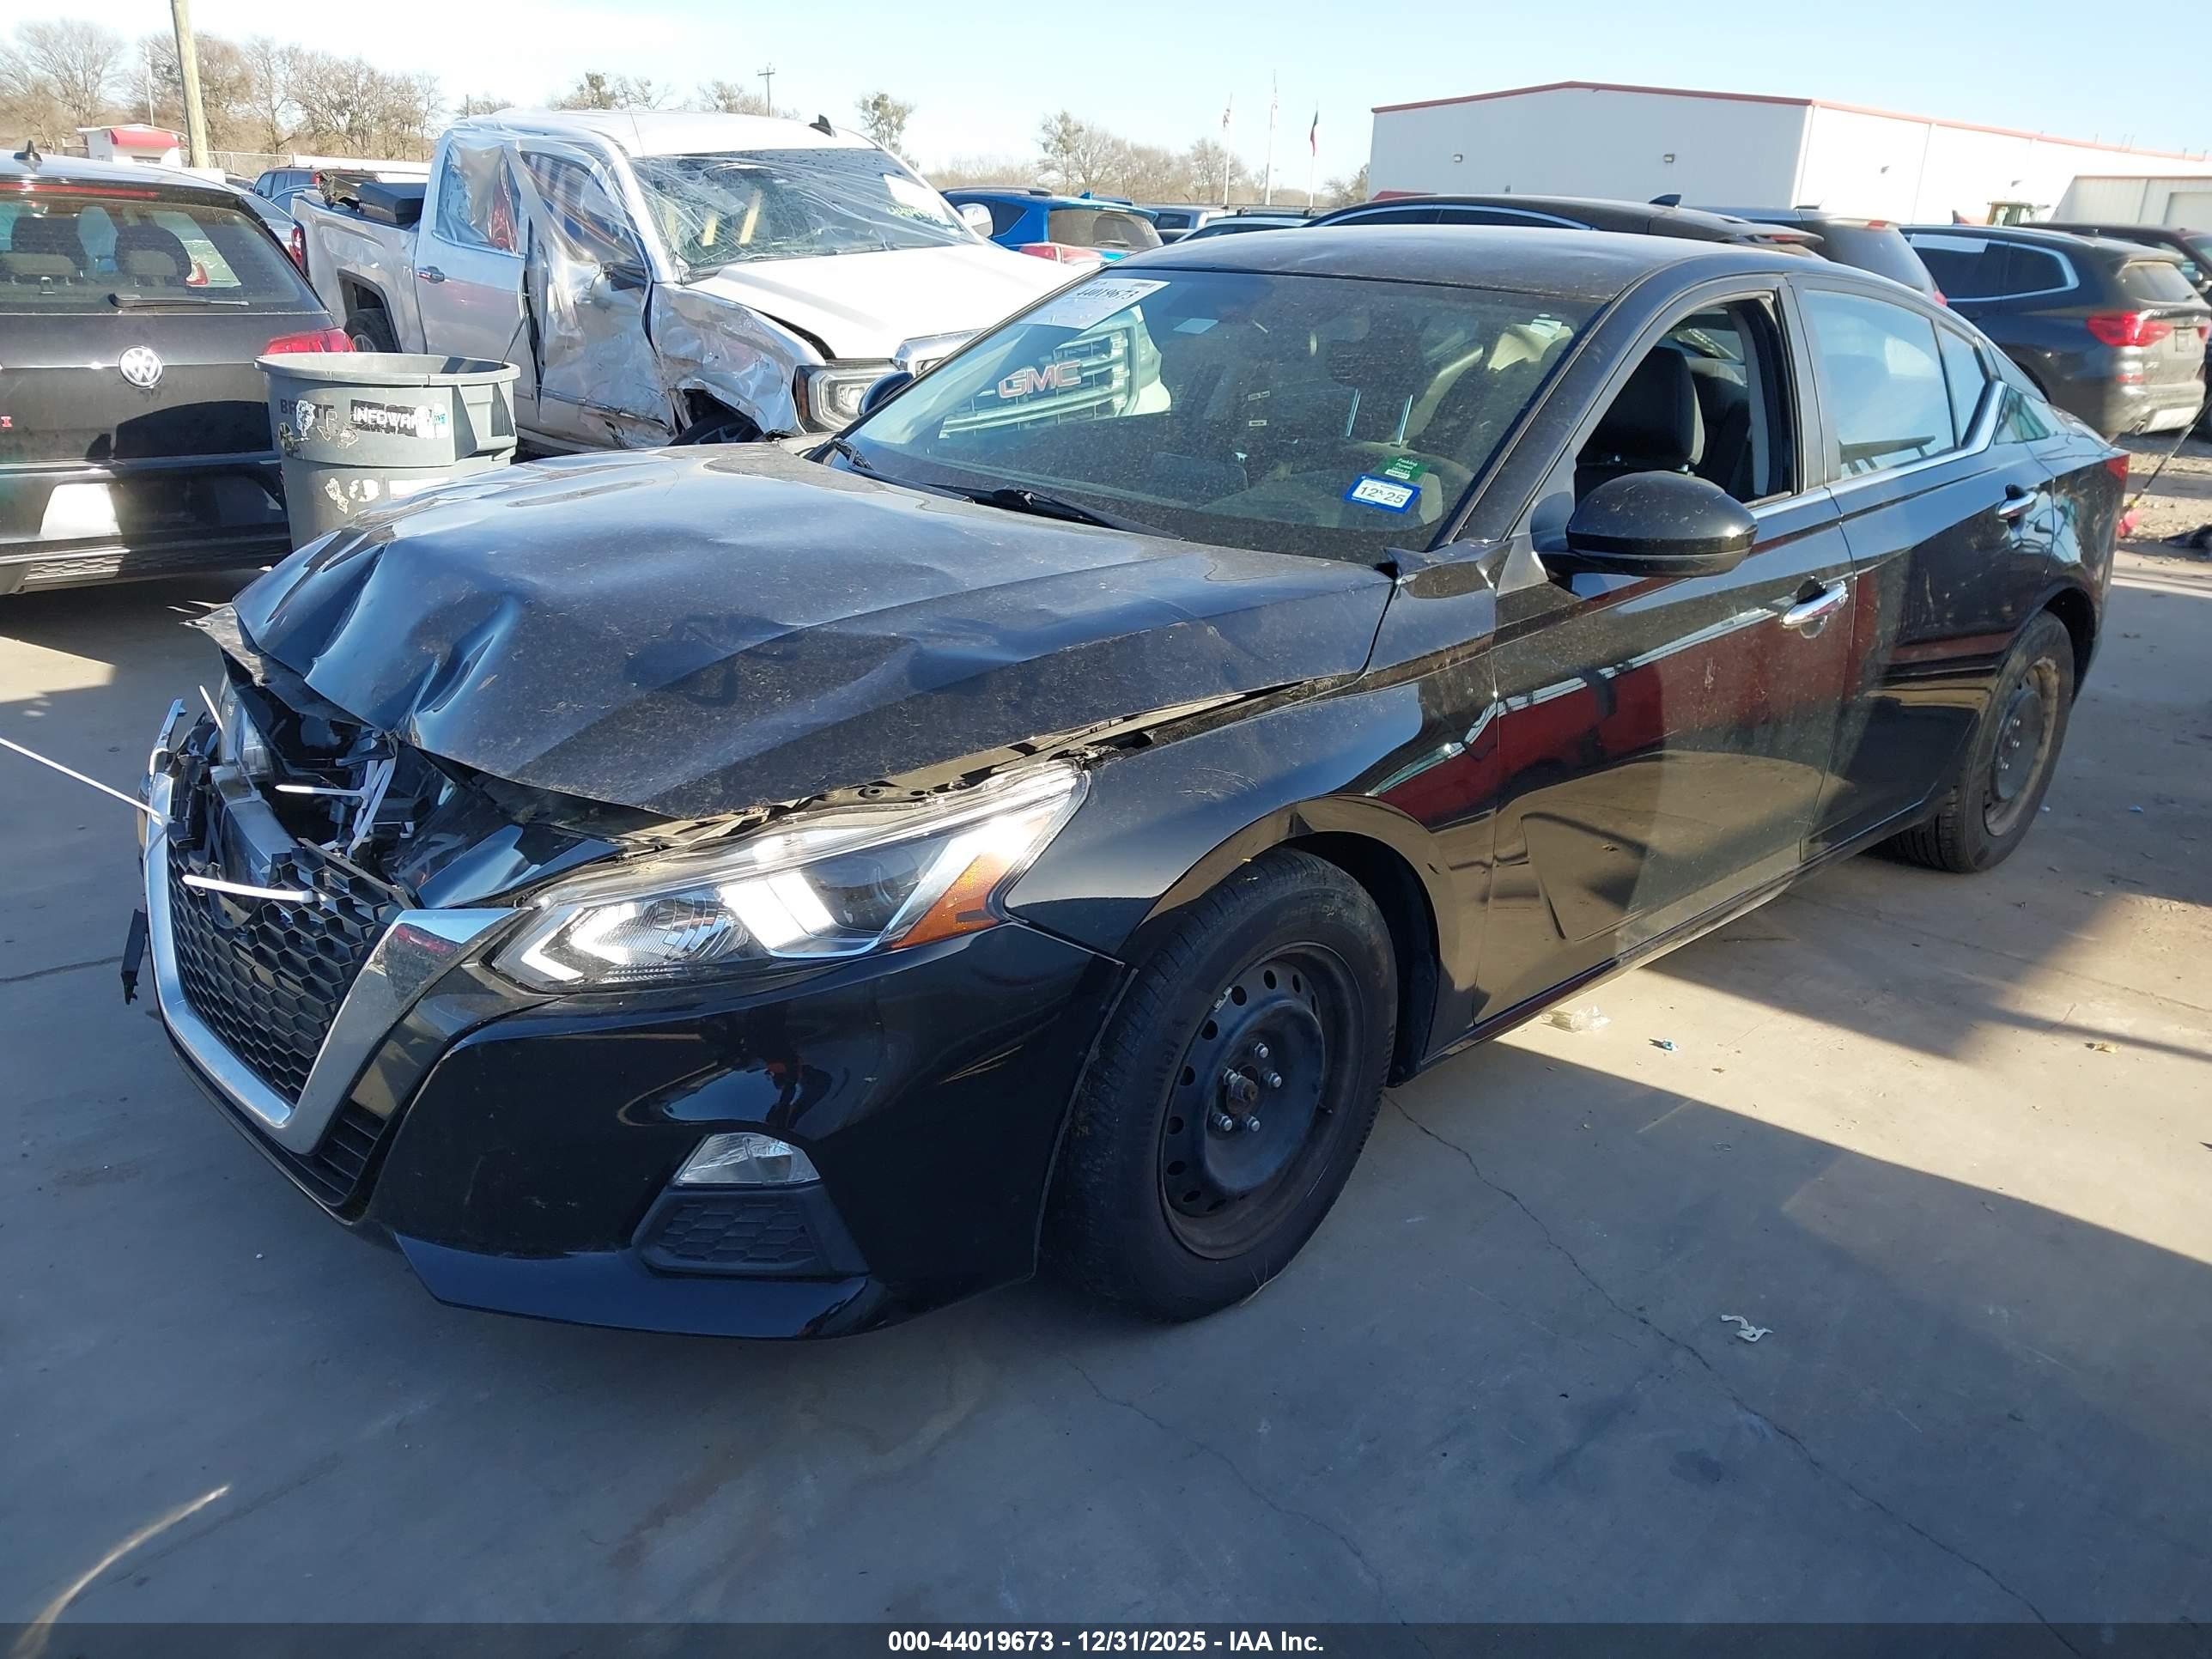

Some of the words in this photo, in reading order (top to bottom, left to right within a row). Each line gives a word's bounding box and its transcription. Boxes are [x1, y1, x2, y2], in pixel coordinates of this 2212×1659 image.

[998, 359, 1082, 399] GMC
[1360, 486, 1379, 498] 12
[1383, 491, 1407, 503] 25
